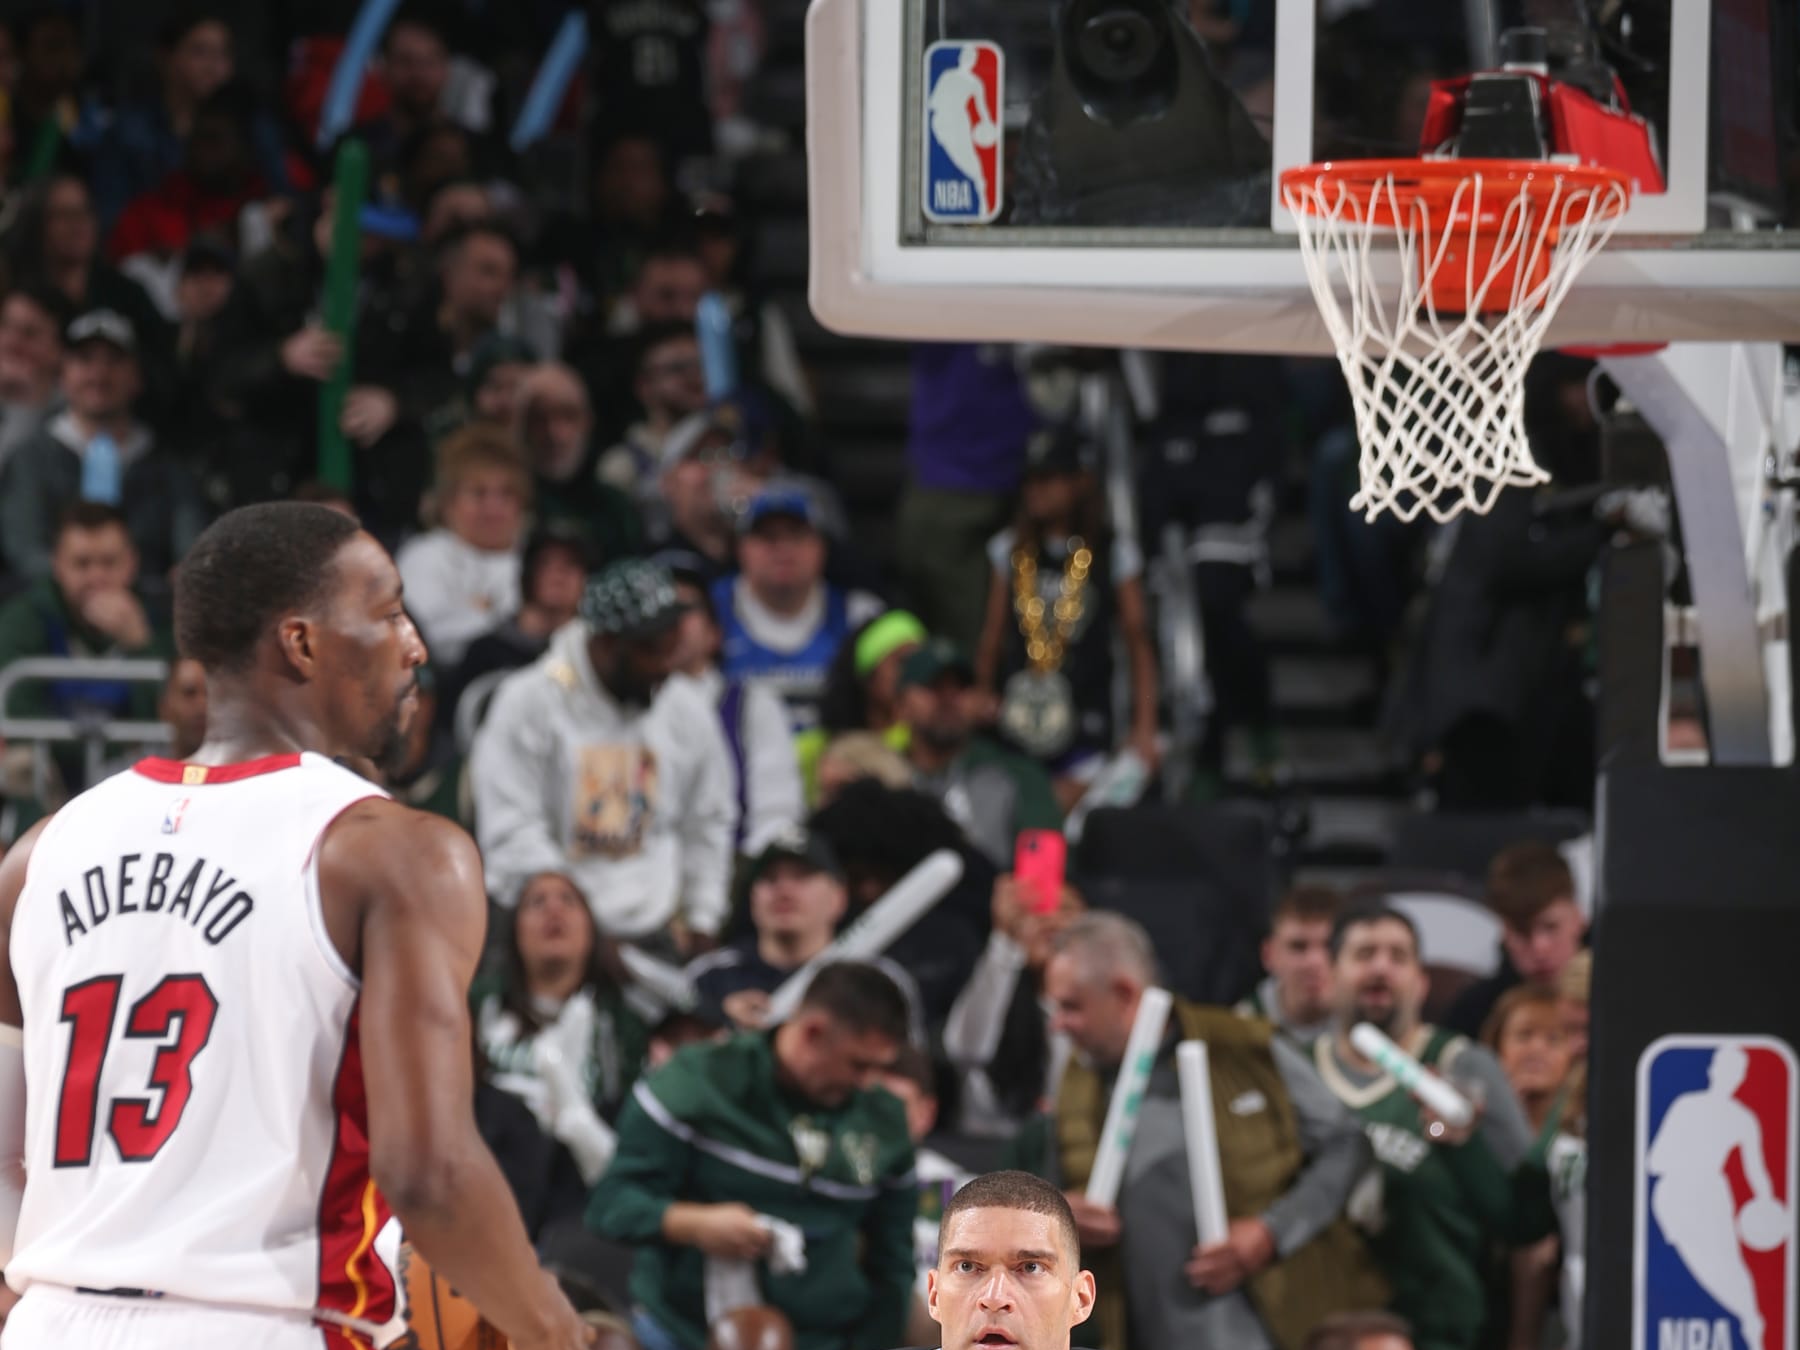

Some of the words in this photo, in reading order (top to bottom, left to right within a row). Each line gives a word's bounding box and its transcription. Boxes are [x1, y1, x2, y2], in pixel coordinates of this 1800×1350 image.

[933, 179, 973, 212] NBA
[57, 852, 254, 946] ADEBAYO
[53, 972, 219, 1168] 13
